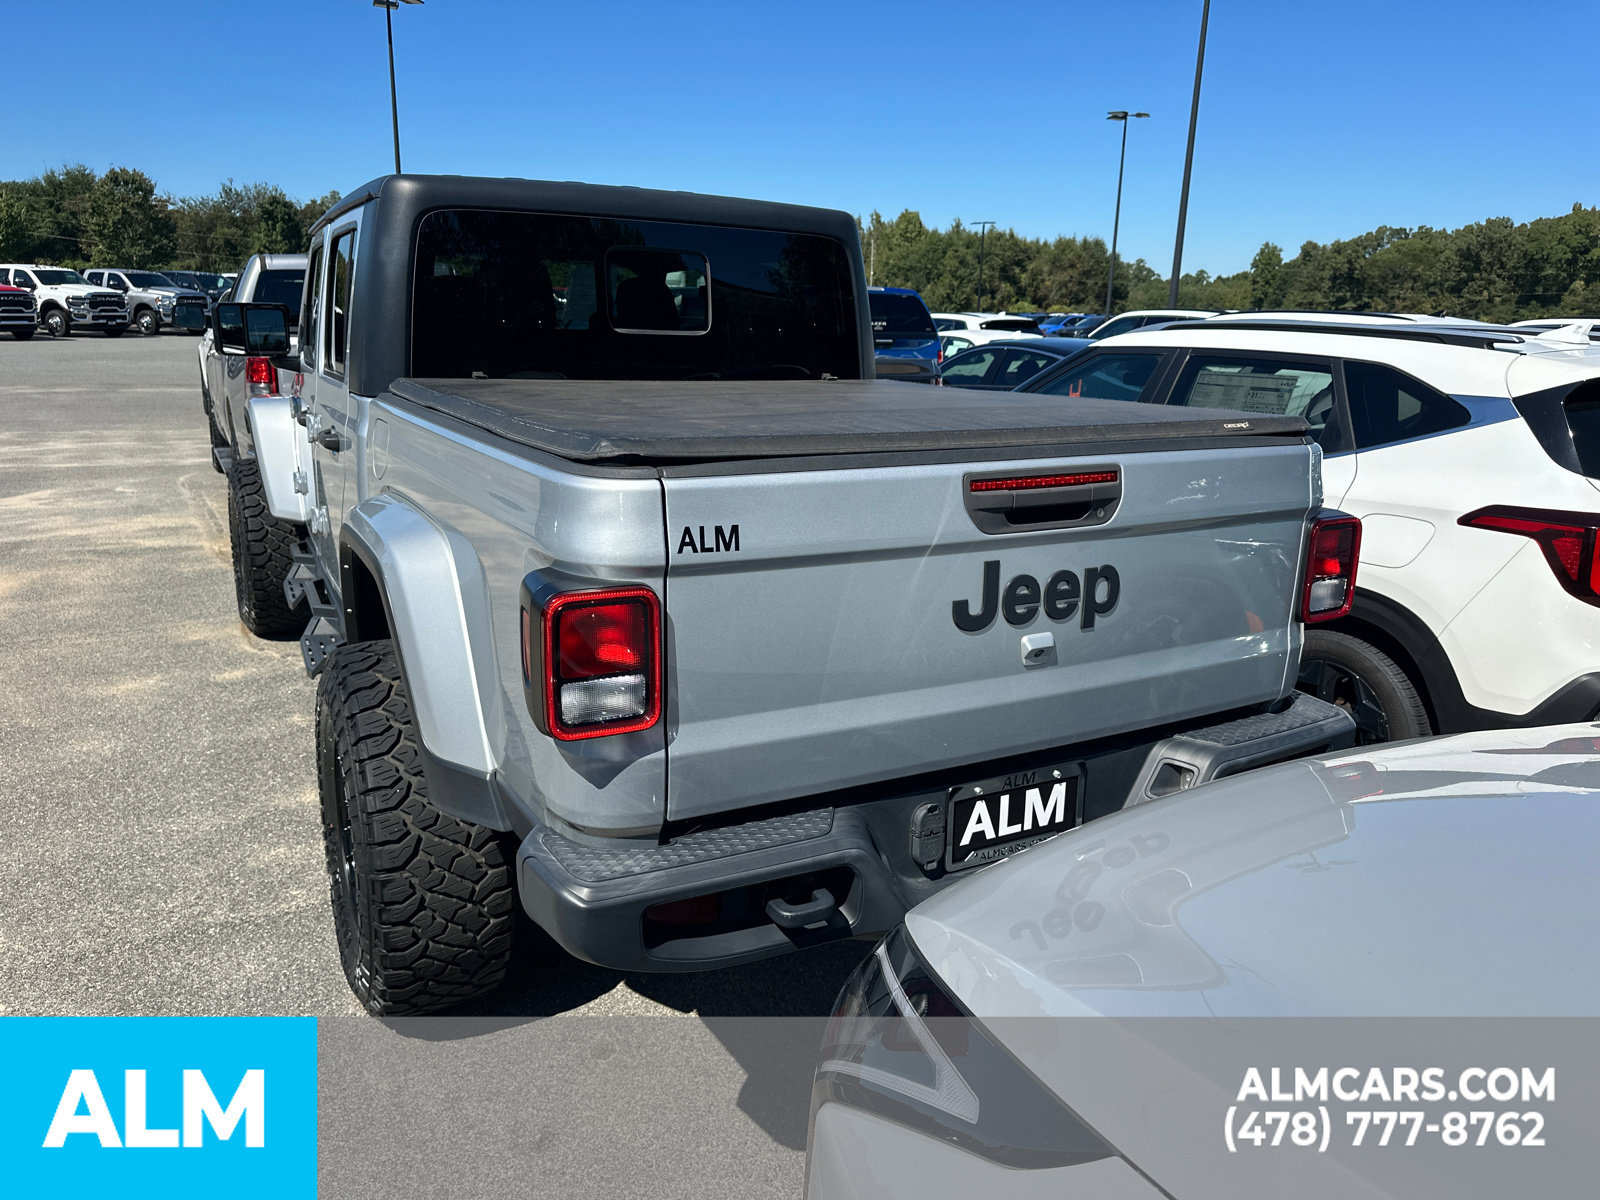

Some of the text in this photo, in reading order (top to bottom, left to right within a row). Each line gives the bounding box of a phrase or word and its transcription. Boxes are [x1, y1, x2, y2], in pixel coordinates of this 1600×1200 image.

[677, 524, 740, 555] ALM
[952, 559, 1121, 633] Jeep
[1002, 771, 1036, 790] ALM
[959, 781, 1067, 847] ALM
